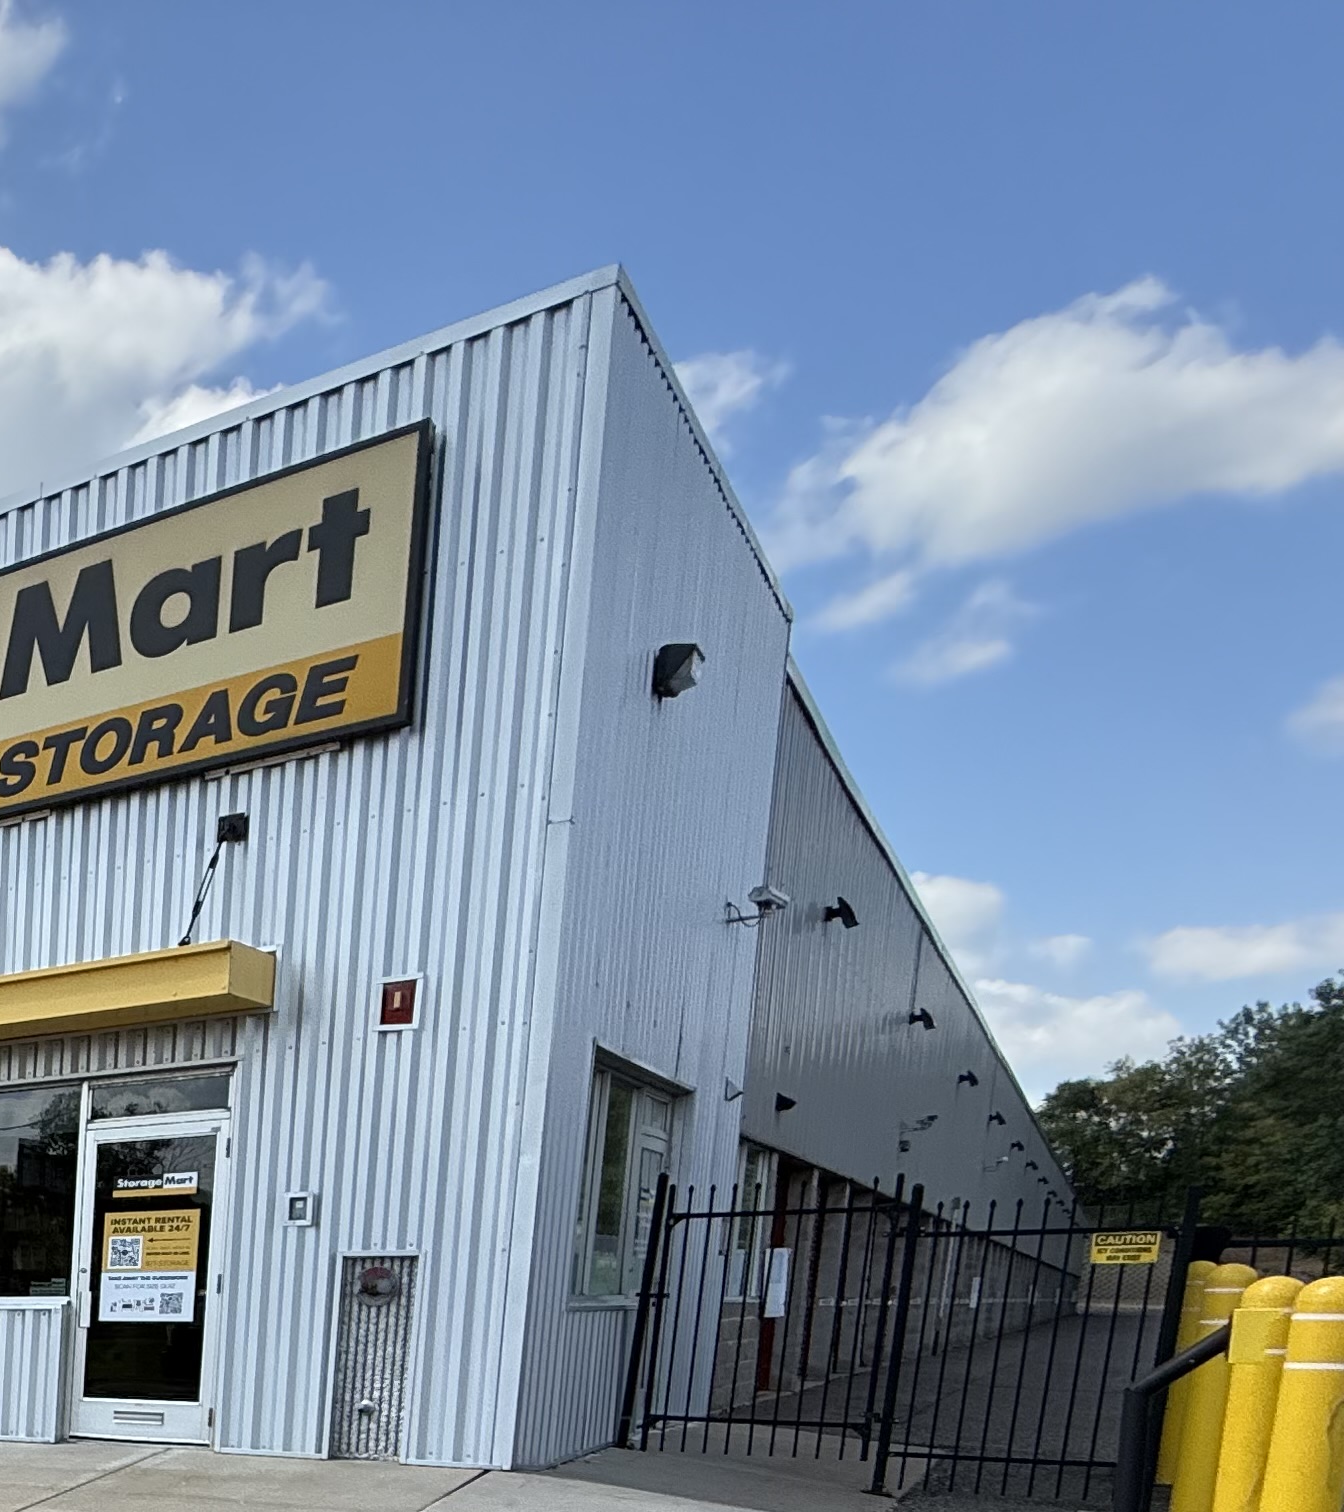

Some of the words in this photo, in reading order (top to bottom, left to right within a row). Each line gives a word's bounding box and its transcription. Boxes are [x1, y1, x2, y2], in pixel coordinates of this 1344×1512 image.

[111, 1218, 151, 1226] INSTANT
[155, 1216, 193, 1224] RENTAL
[112, 1225, 165, 1234] AVAILABLE
[168, 1224, 190, 1232] 24/7
[1098, 1235, 1155, 1244] CAUTION
